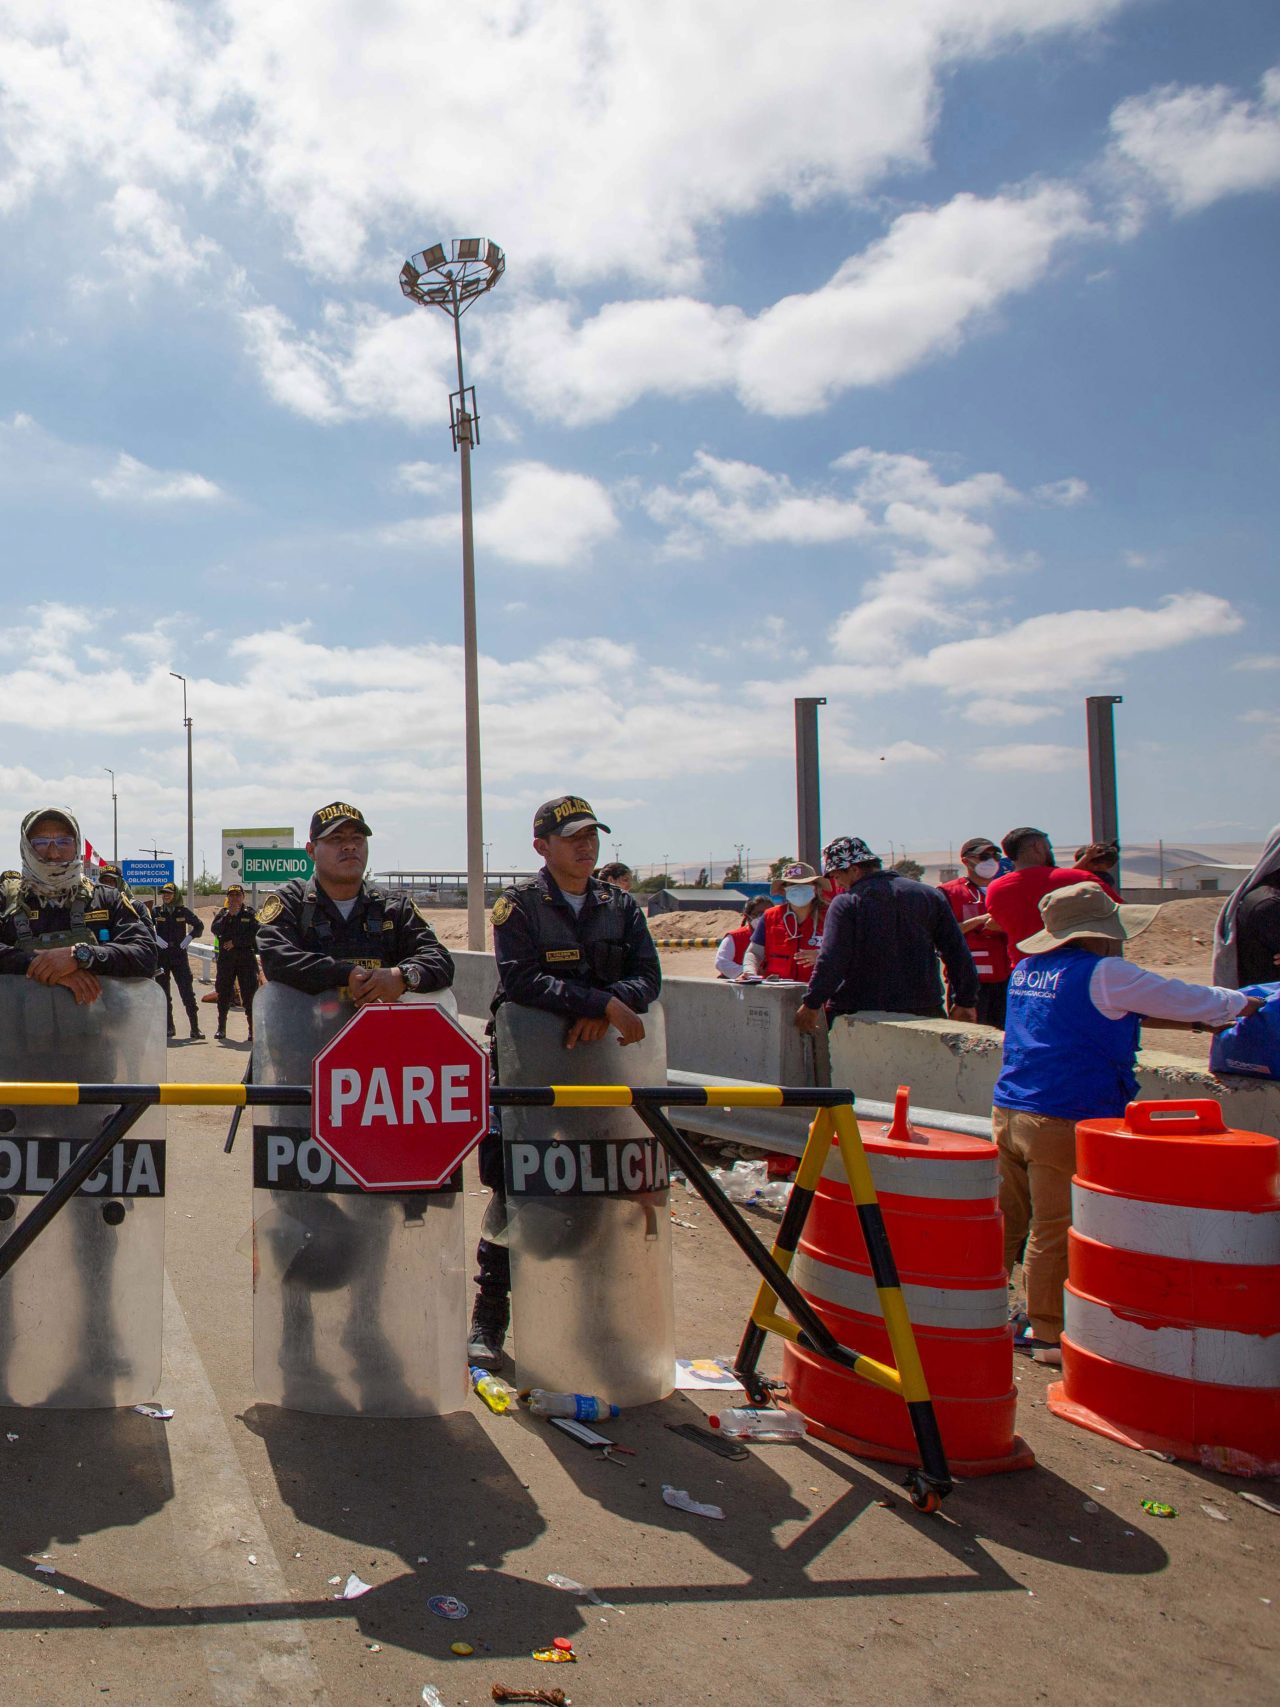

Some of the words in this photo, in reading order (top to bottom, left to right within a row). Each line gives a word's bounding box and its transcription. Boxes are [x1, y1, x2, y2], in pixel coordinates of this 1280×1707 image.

[317, 804, 360, 824] POLICIA
[245, 858, 307, 872] BIENVENIDO
[1027, 970, 1060, 991] OIM
[330, 1064, 471, 1128] PARE
[511, 1141, 669, 1193] POLICIA
